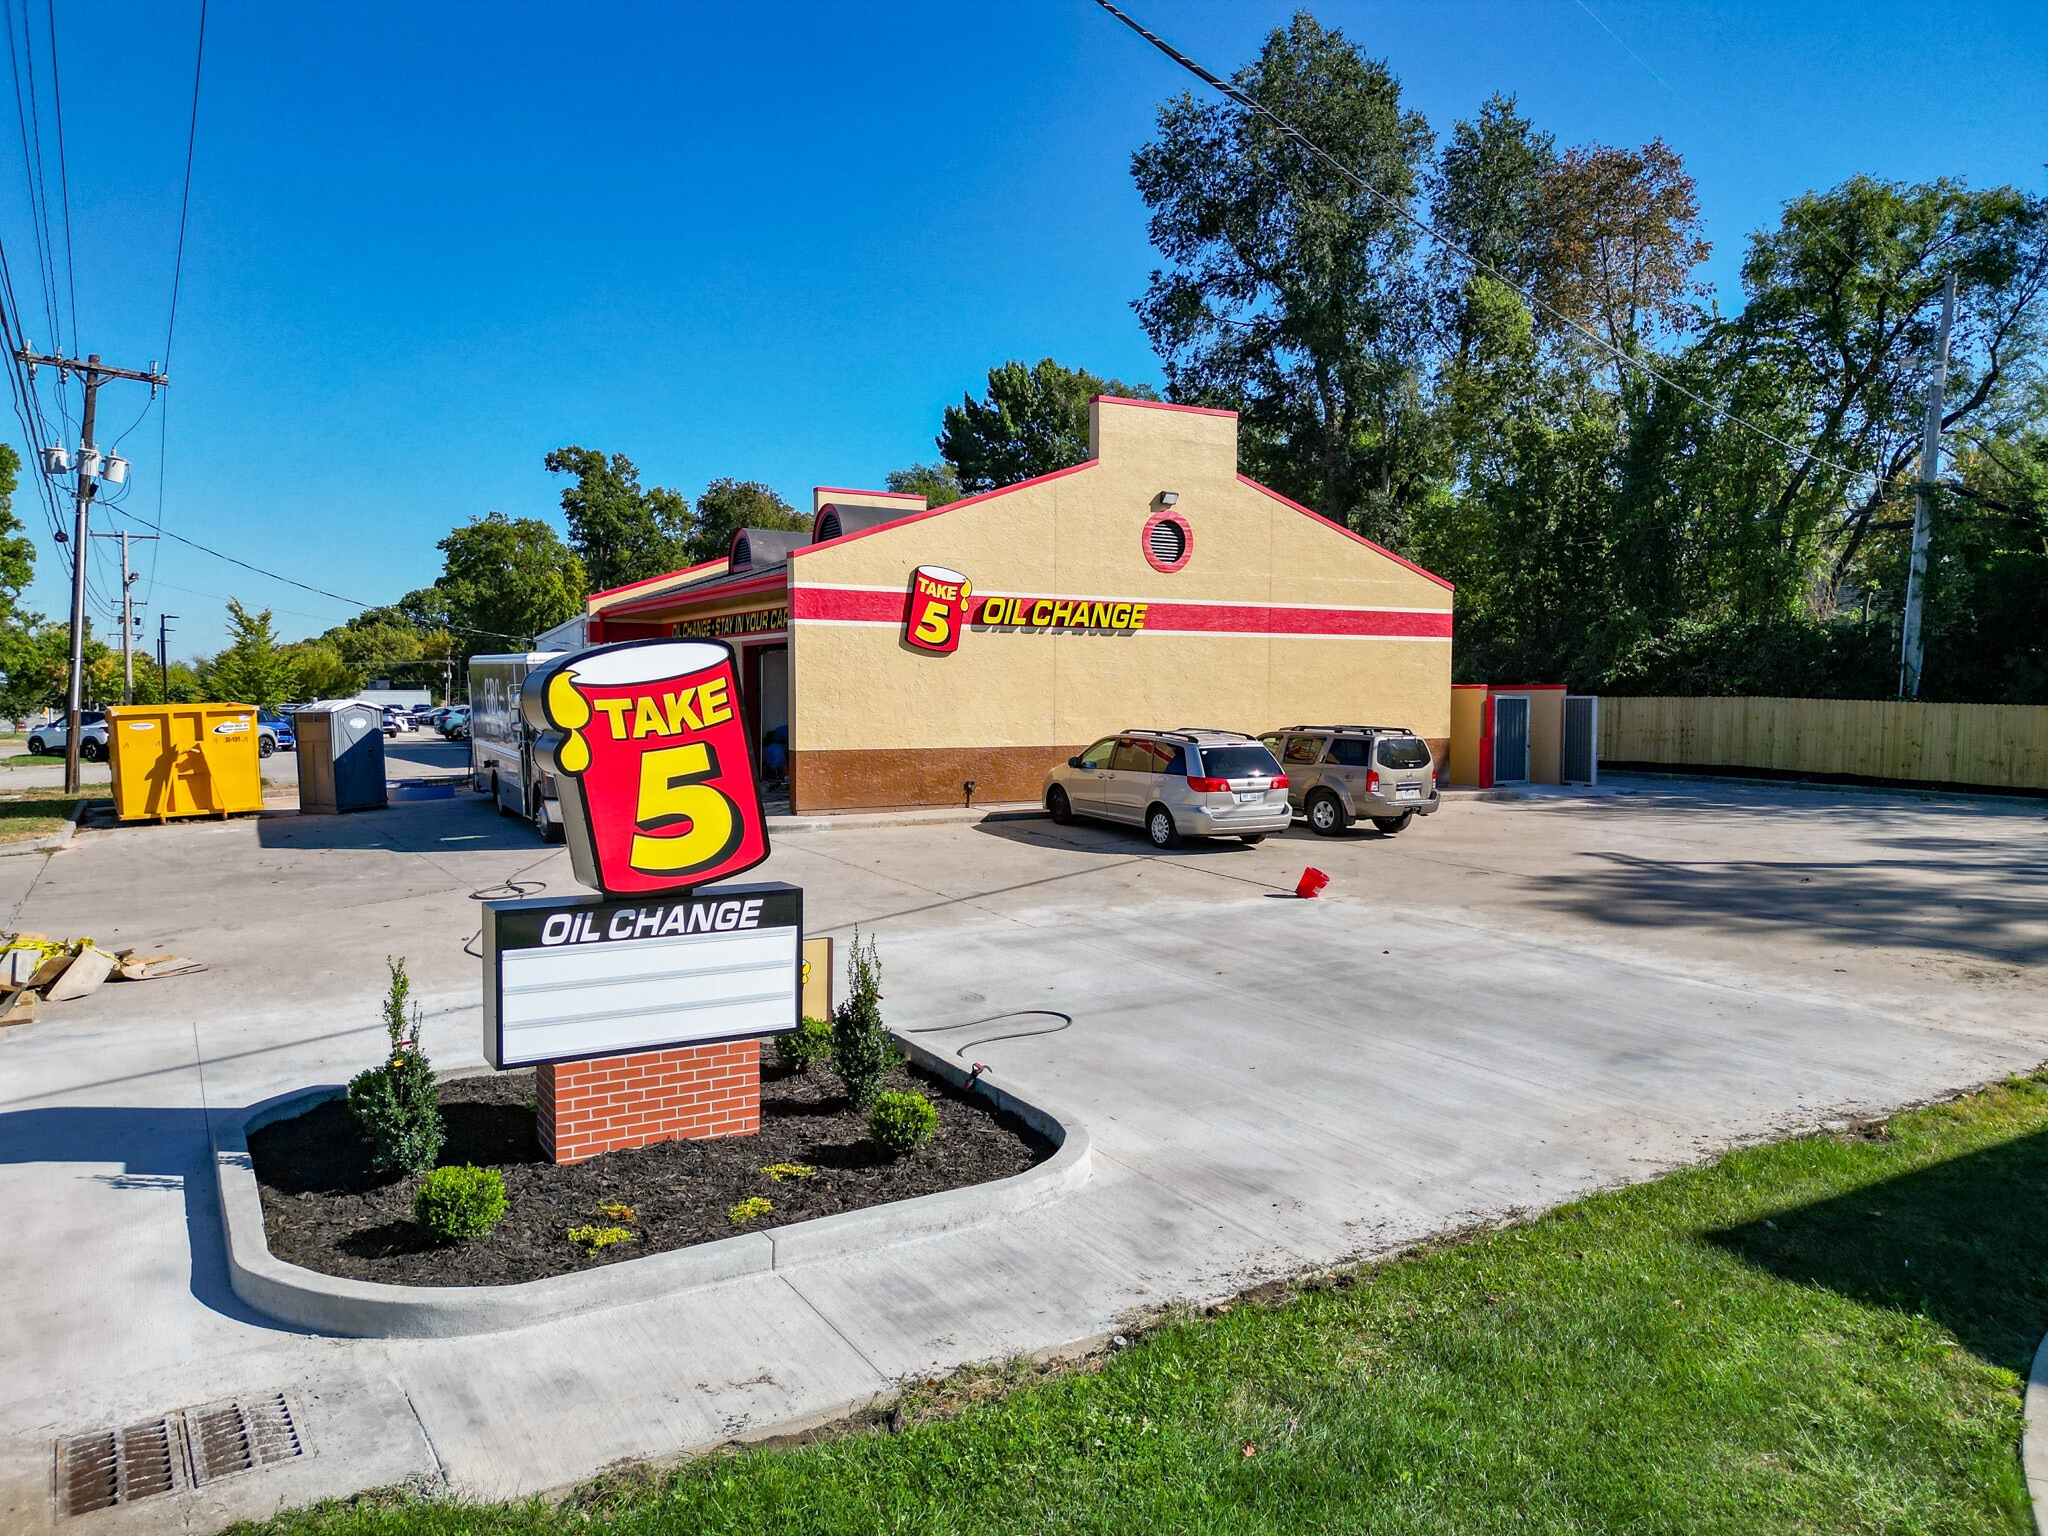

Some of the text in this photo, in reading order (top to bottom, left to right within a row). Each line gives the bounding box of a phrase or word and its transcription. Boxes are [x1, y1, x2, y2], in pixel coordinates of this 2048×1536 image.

[918, 577, 957, 601] TAKE
[683, 619, 712, 637] CHANGE
[715, 615, 733, 635] STAY
[735, 615, 744, 633] IN
[745, 611, 768, 631] YOUR
[914, 600, 949, 644] 5
[982, 597, 1148, 629] OIL CHANGE
[593, 676, 733, 740] TAKE
[629, 741, 736, 871] 5
[541, 899, 764, 946] OIL CHANGE
